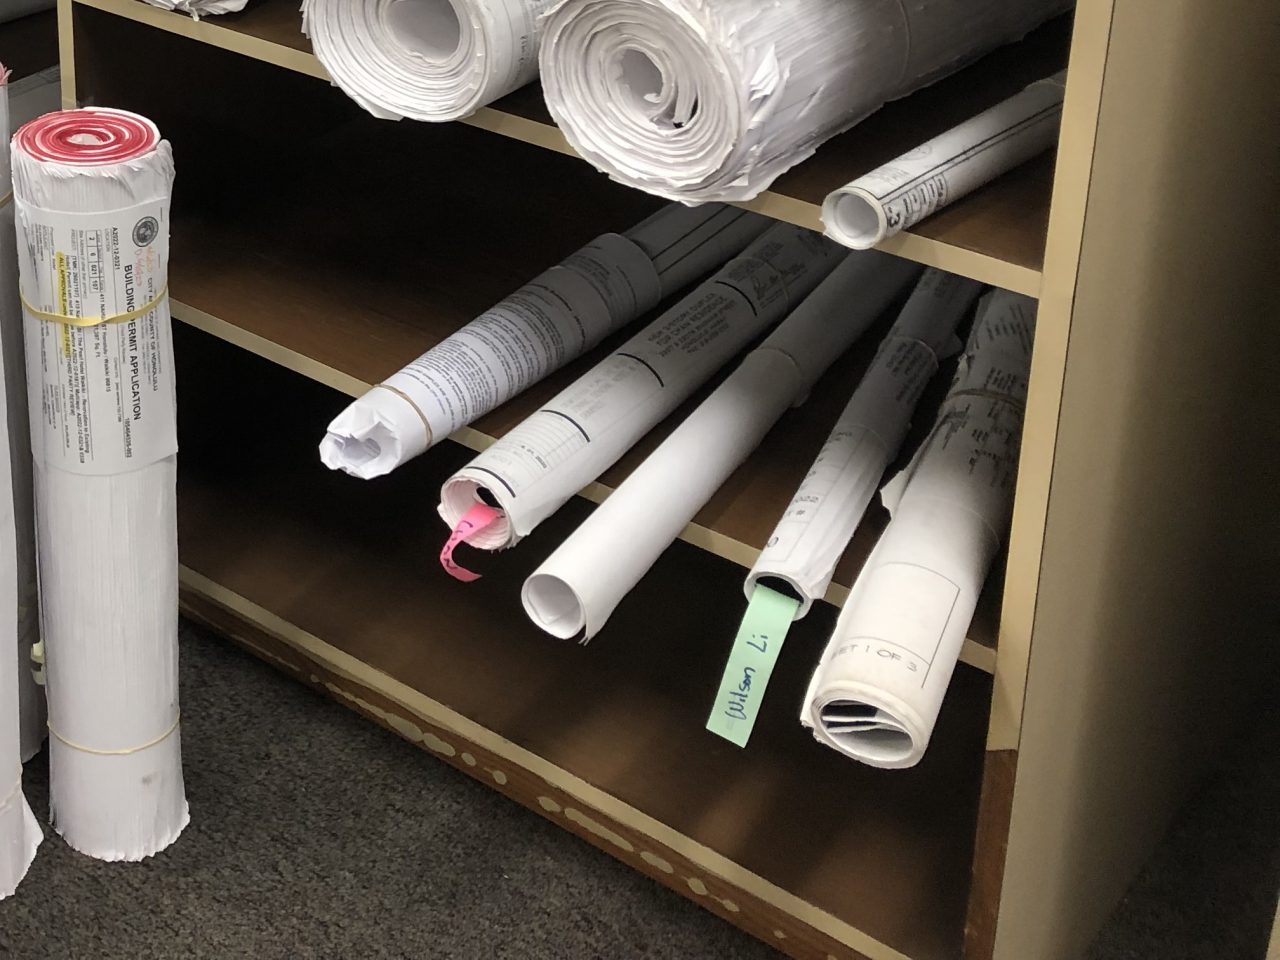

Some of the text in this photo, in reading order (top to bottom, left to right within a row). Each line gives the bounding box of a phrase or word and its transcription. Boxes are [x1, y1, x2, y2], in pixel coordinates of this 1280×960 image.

[124, 264, 135, 312] BUILDING
[130, 355, 141, 421] APPLICATION
[724, 633, 769, 720] Wilson Li
[876, 650, 902, 663] OF
